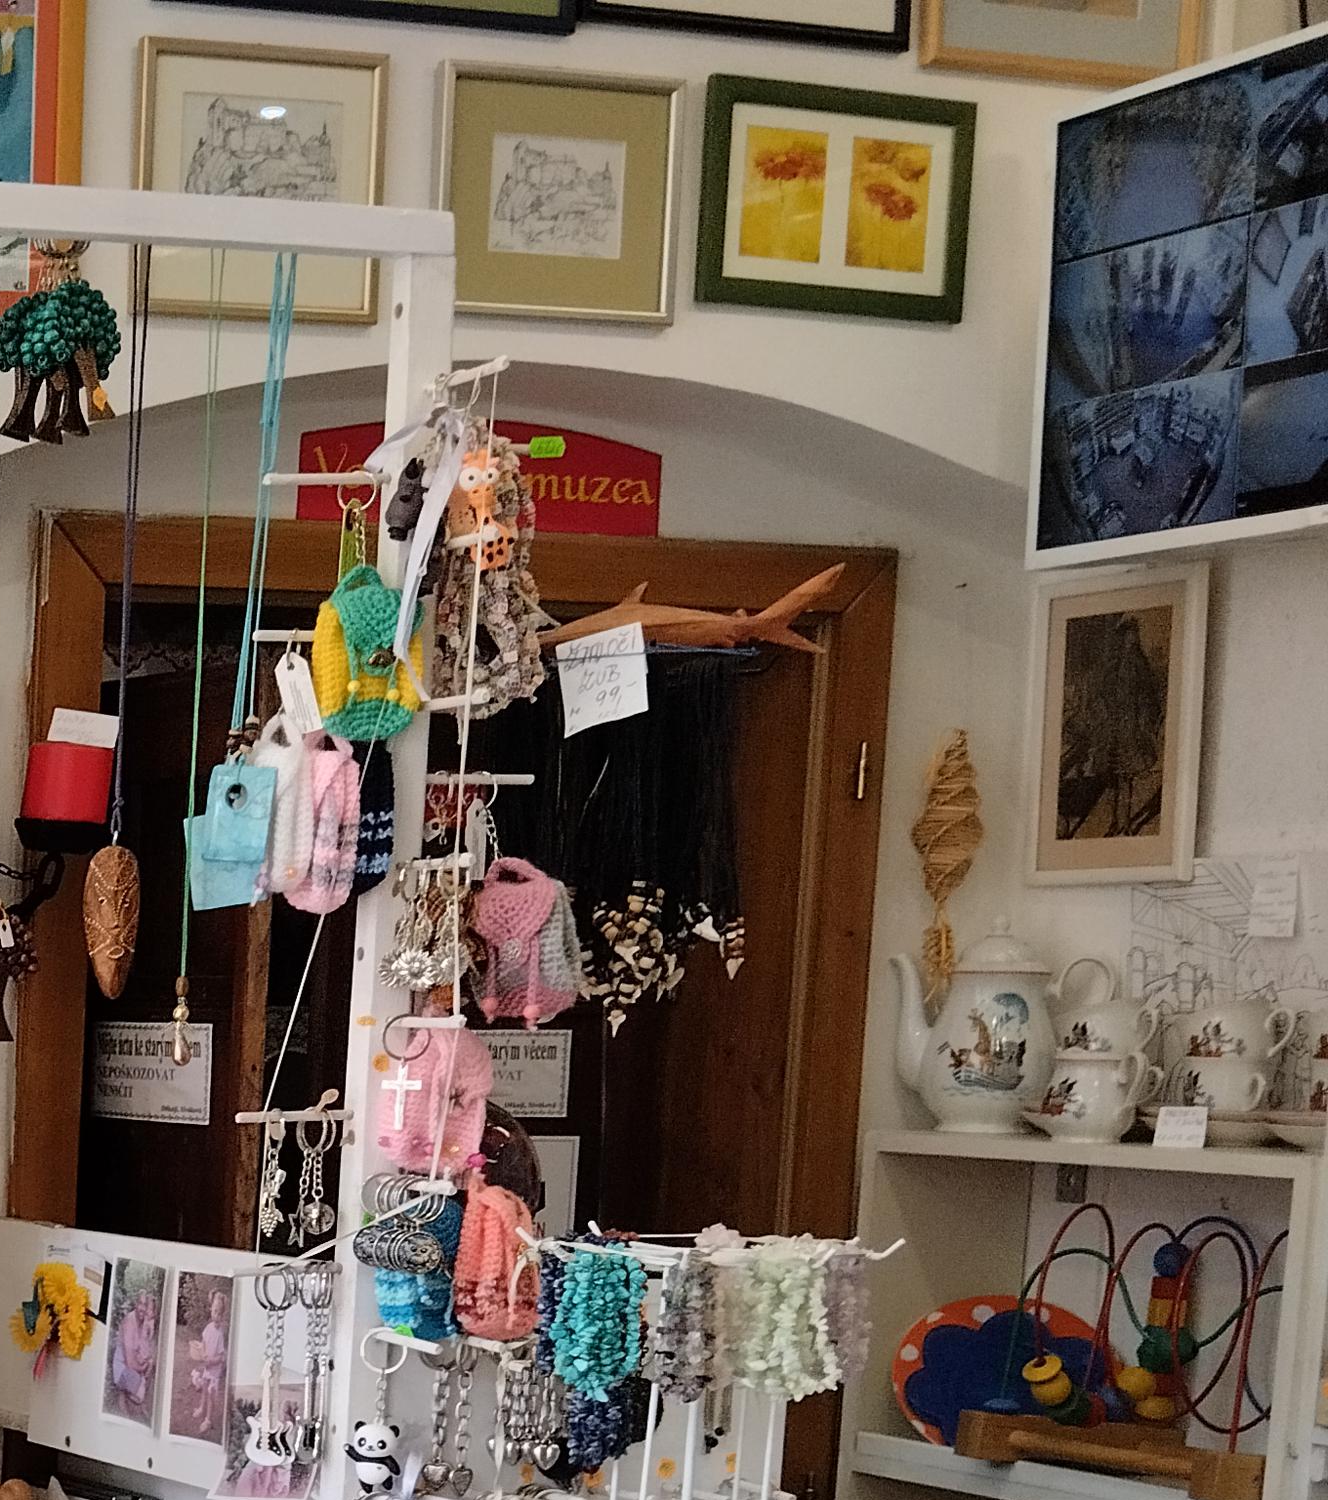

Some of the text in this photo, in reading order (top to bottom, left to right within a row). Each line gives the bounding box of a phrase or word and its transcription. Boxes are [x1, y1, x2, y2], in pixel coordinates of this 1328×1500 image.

[525, 469, 656, 506] muzea
[145, 1034, 173, 1064] starým
[96, 1063, 176, 1080] NEPOŠKOZOVAT
